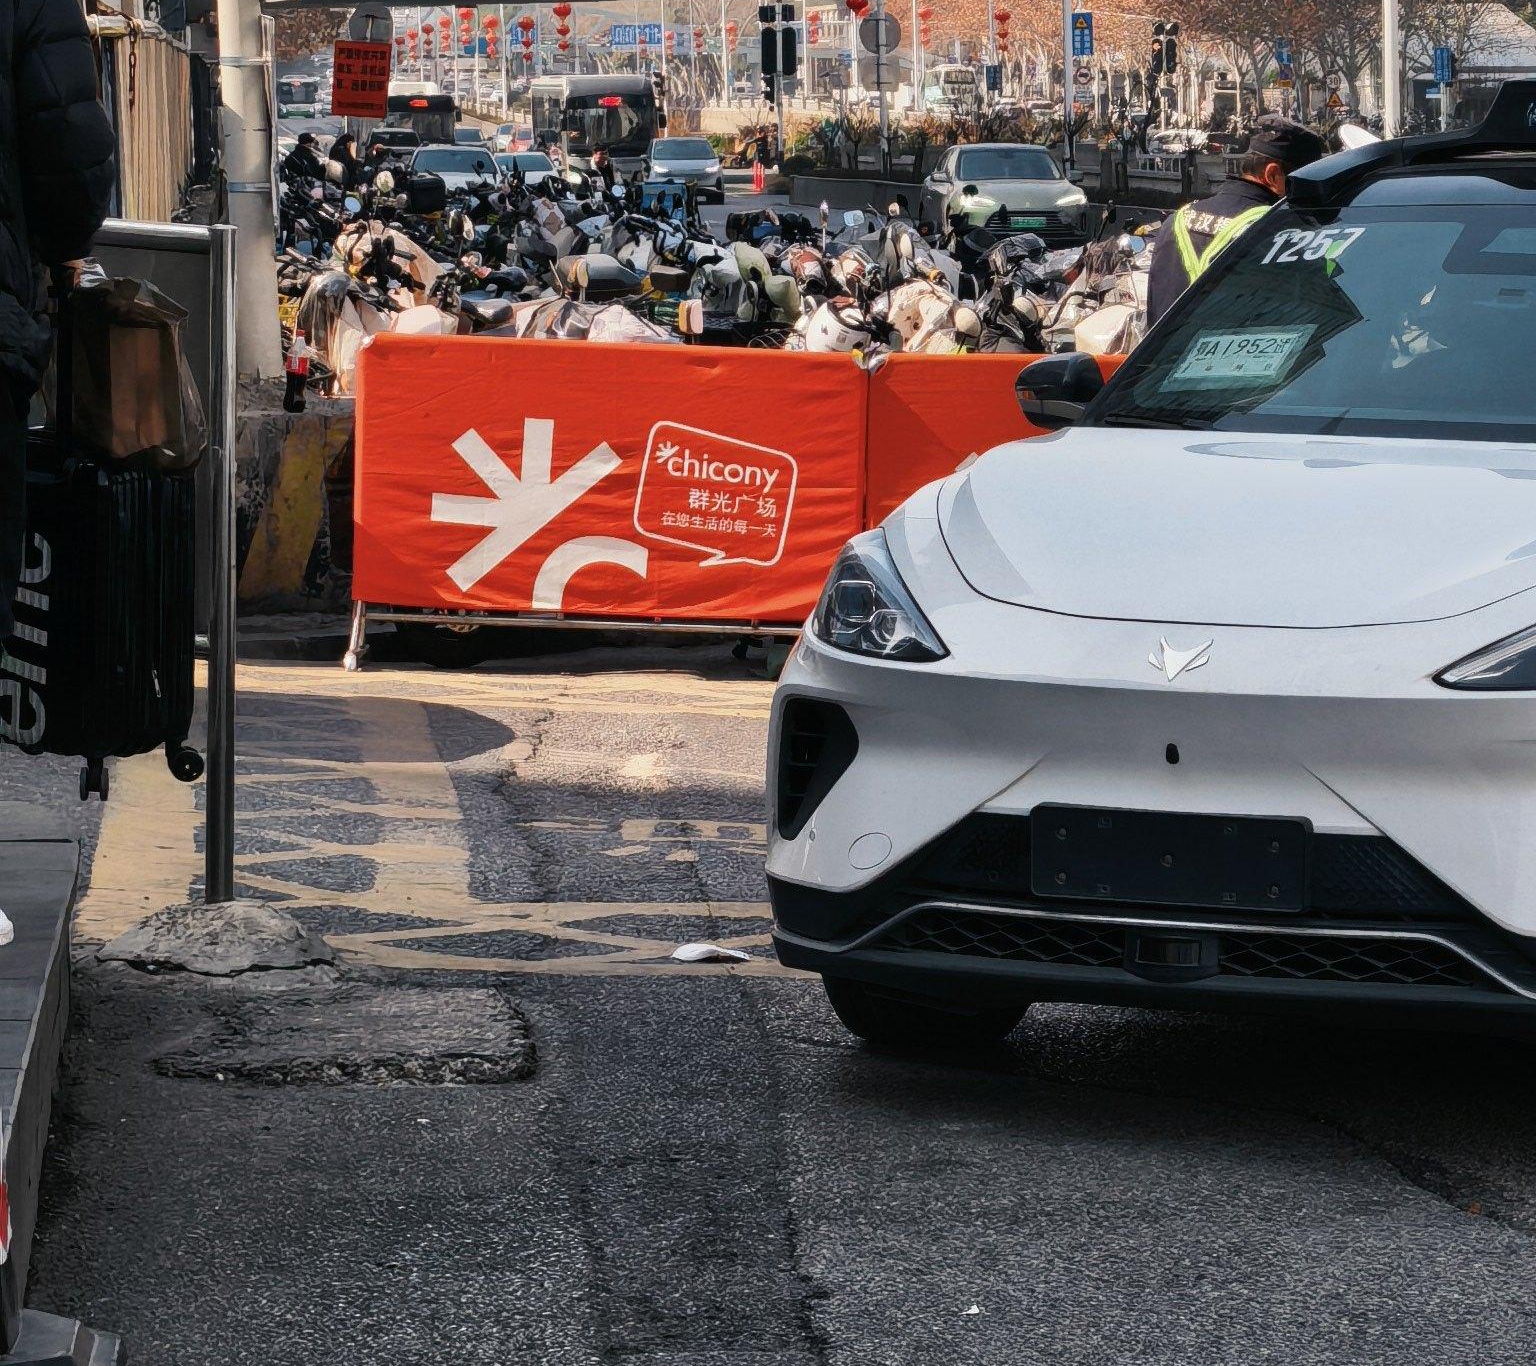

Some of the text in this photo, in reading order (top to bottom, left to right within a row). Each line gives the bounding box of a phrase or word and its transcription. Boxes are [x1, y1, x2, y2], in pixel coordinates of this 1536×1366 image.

[667, 448, 780, 494] chicony
[688, 488, 777, 518] 群光广场
[660, 510, 777, 538] 在您生活的每一天
